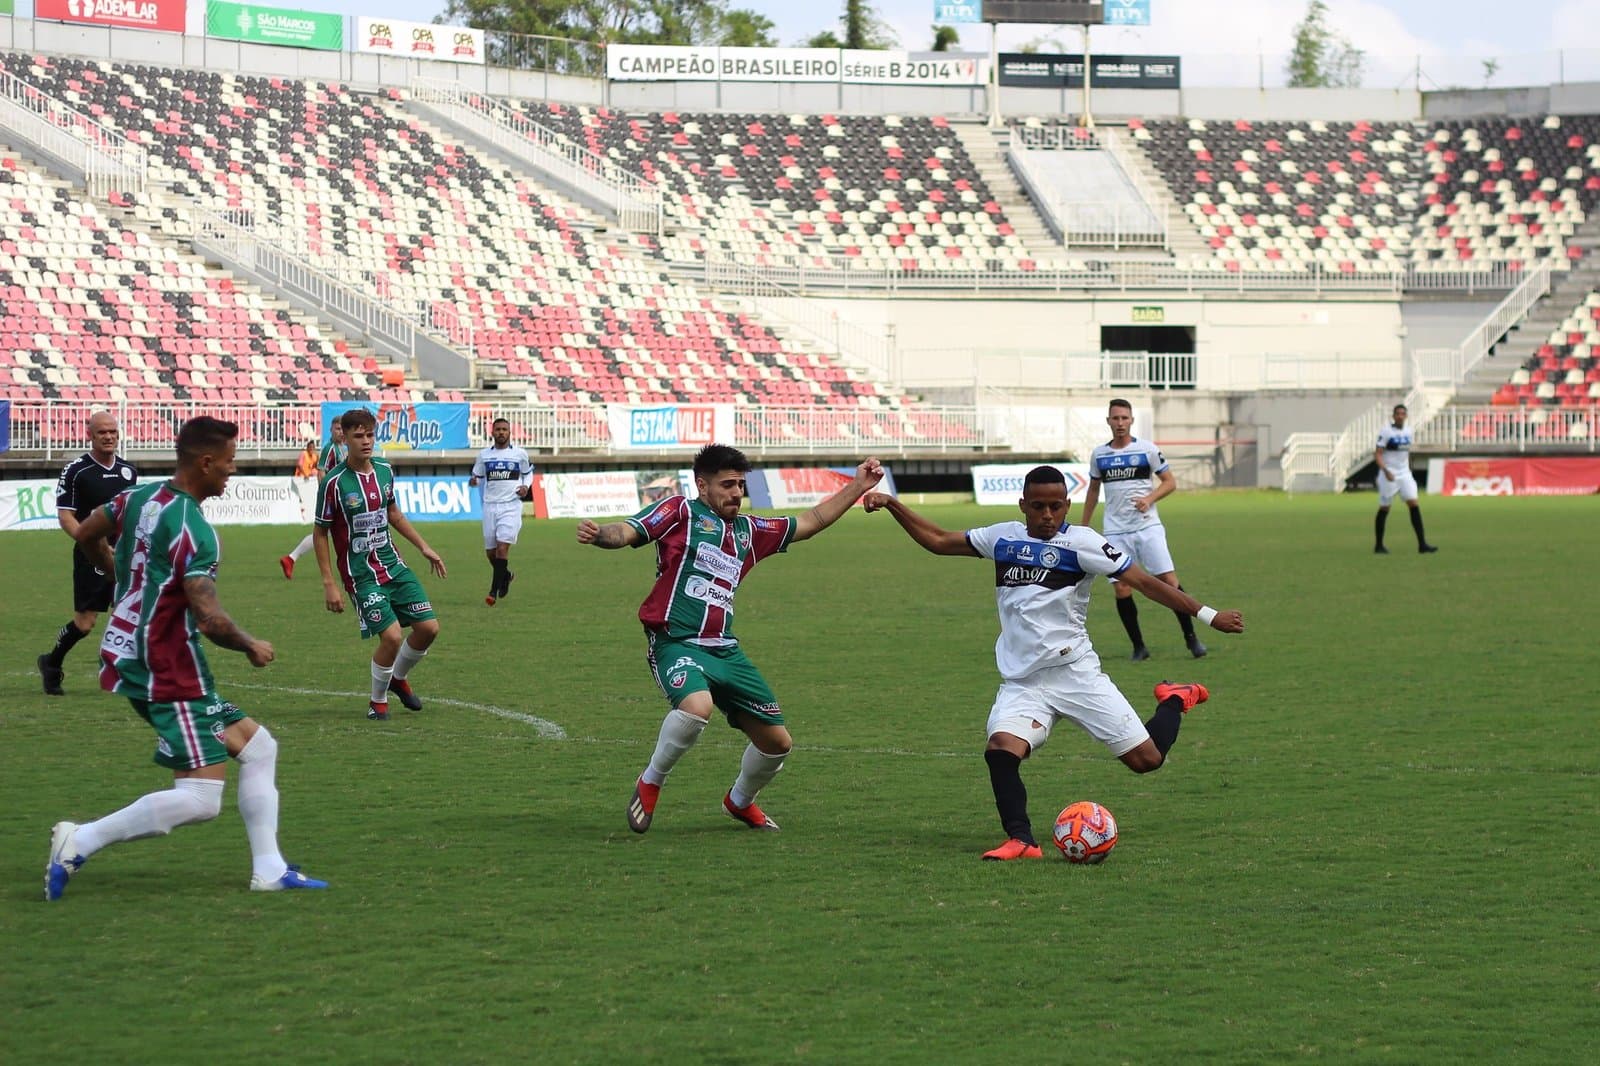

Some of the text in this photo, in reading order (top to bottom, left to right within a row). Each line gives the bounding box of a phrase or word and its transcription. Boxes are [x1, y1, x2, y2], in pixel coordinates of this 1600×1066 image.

[94, 0, 158, 20] ADEMILAR
[369, 23, 392, 38] OPA
[412, 28, 434, 42] OPA
[453, 33, 474, 46] OPA
[619, 54, 951, 78] CAMPEÃO BRASILEIRO SÉRIE B 2014
[235, 483, 292, 500] Gourmet
[394, 481, 471, 513] THLON
[1003, 566, 1051, 583] Althoff
